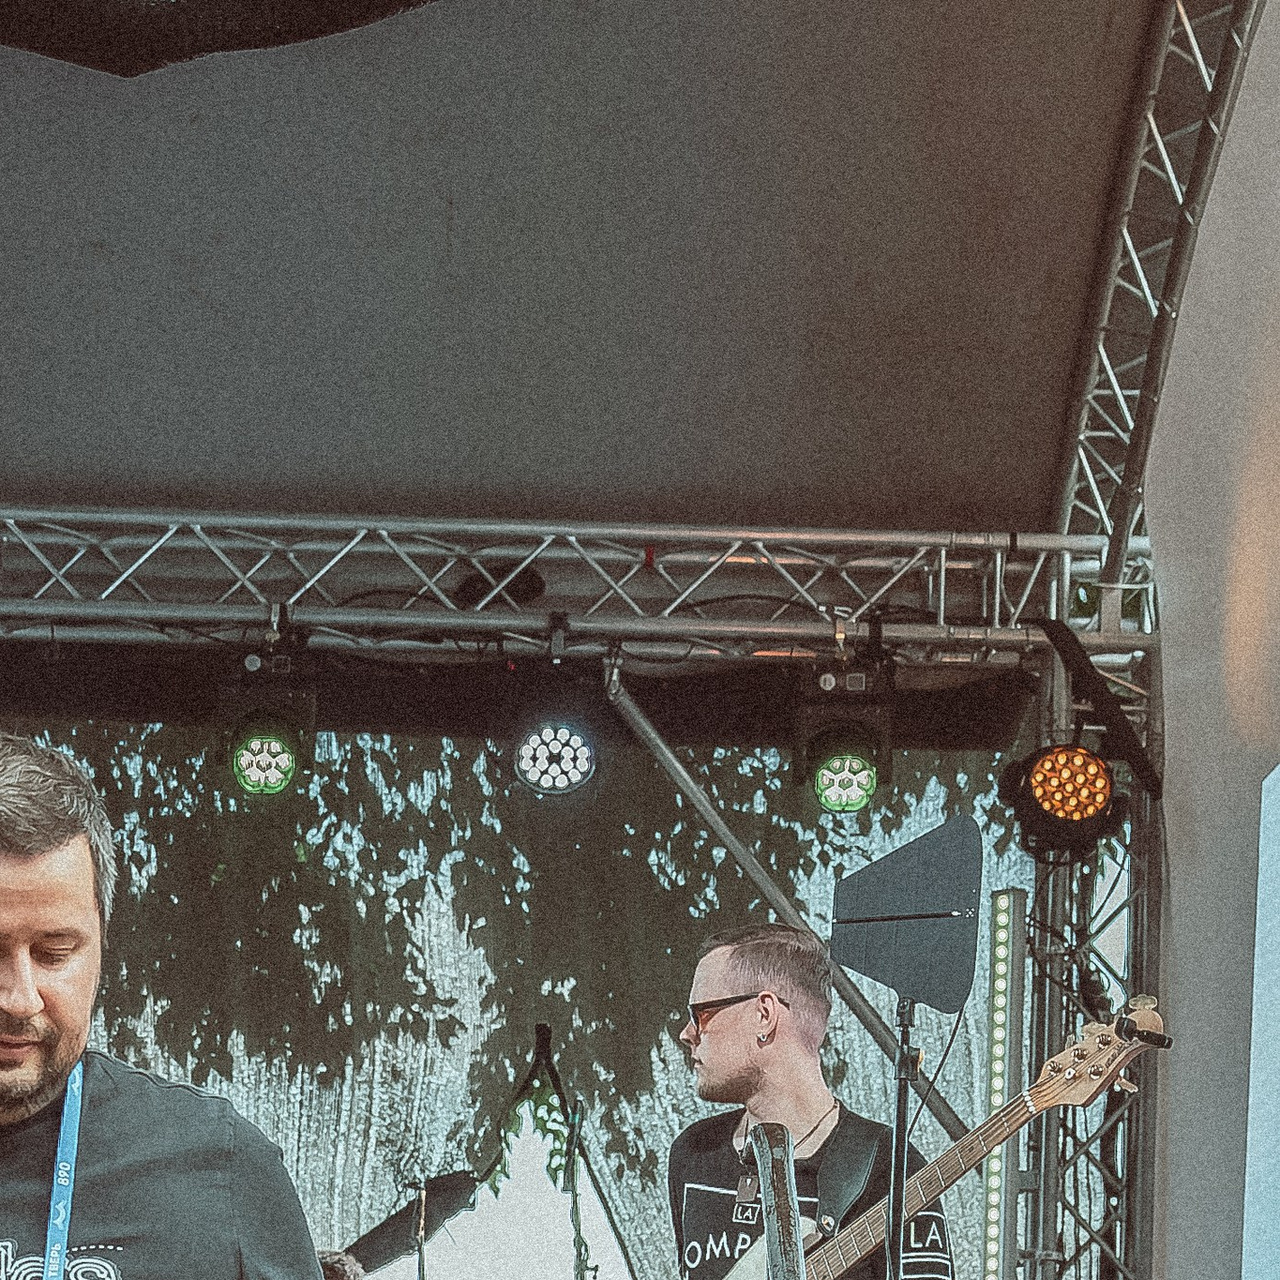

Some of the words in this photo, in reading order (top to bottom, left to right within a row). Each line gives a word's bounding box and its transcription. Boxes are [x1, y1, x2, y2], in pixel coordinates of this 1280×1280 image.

[57, 1161, 71, 1186] 890
[736, 1206, 753, 1220] LA
[910, 1221, 943, 1249] LA
[49, 1243, 62, 1277] ТВЕРЬ
